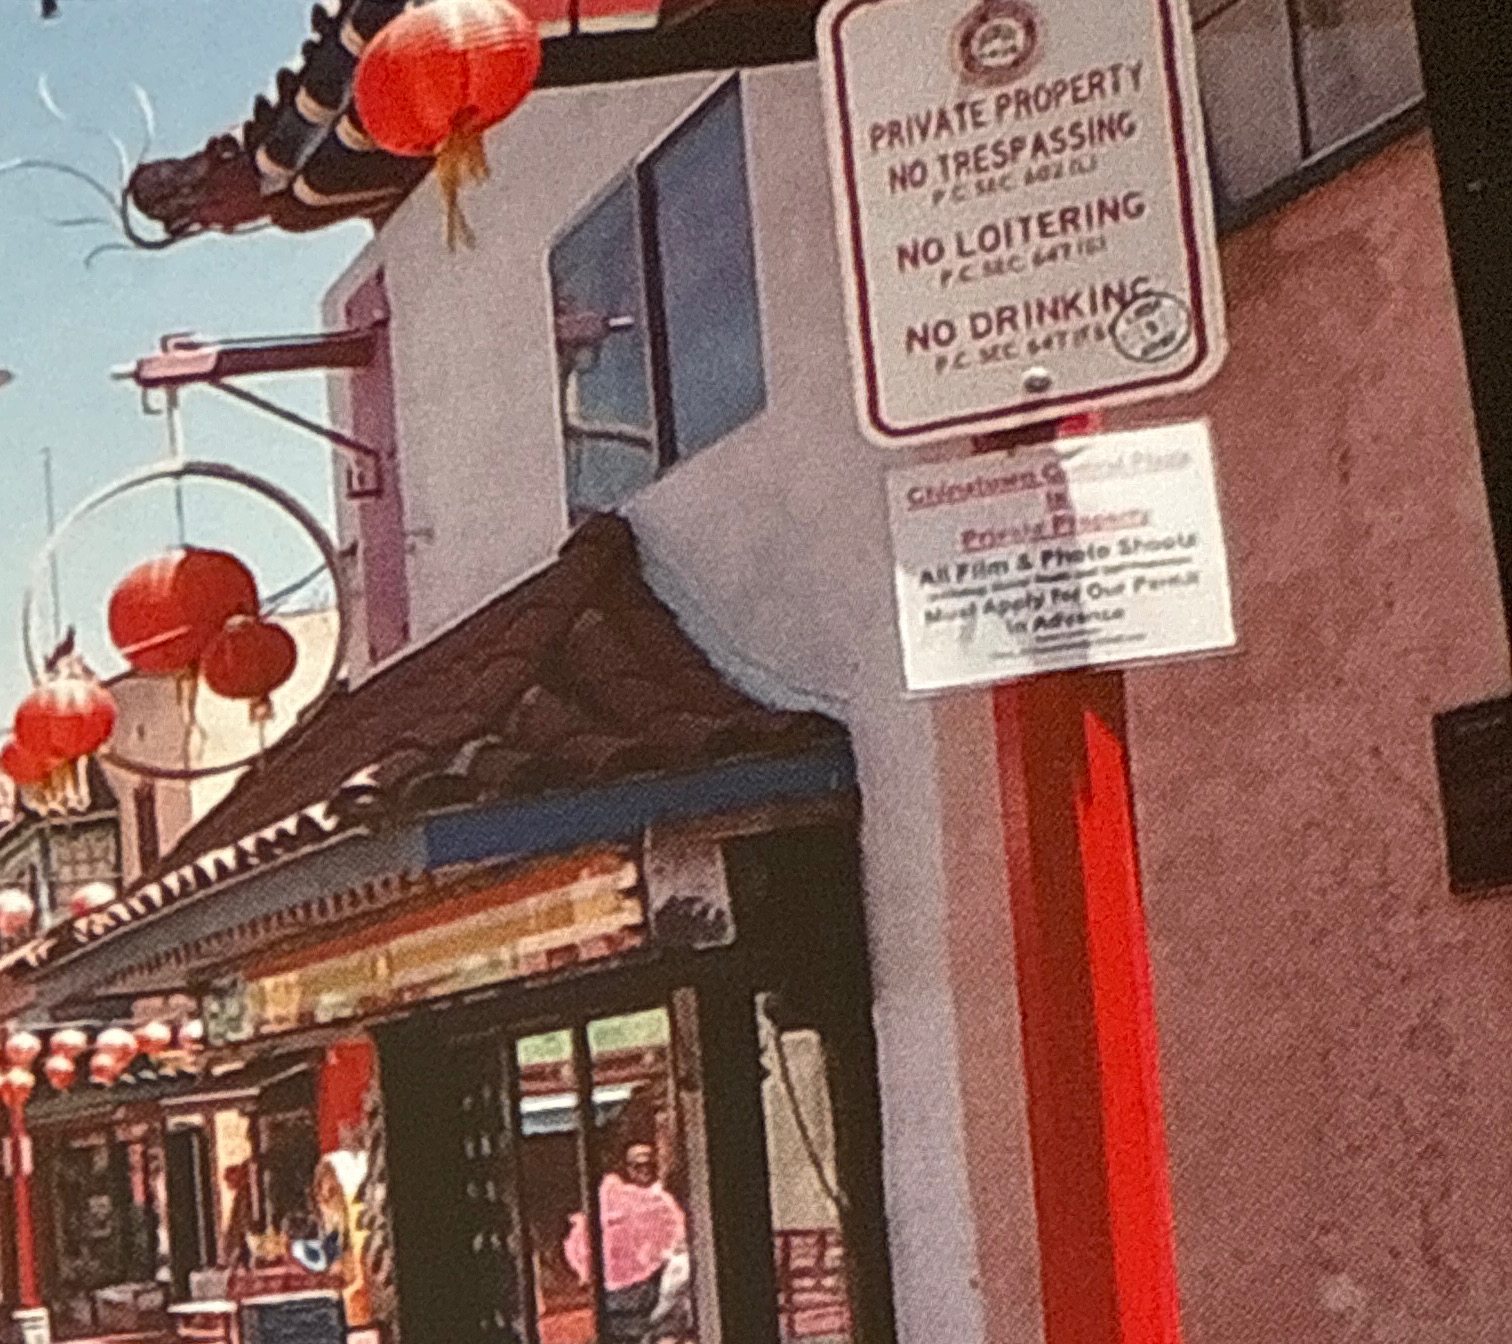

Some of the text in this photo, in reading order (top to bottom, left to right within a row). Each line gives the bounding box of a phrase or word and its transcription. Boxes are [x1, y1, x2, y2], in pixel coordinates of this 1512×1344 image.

[870, 60, 1144, 153] PRIVATE PROPERTY
[889, 110, 1137, 194] NO TRESPASSING
[896, 190, 1146, 274] NO LOITERING
[905, 319, 957, 355] NO
[1040, 543, 1110, 570] Photo
